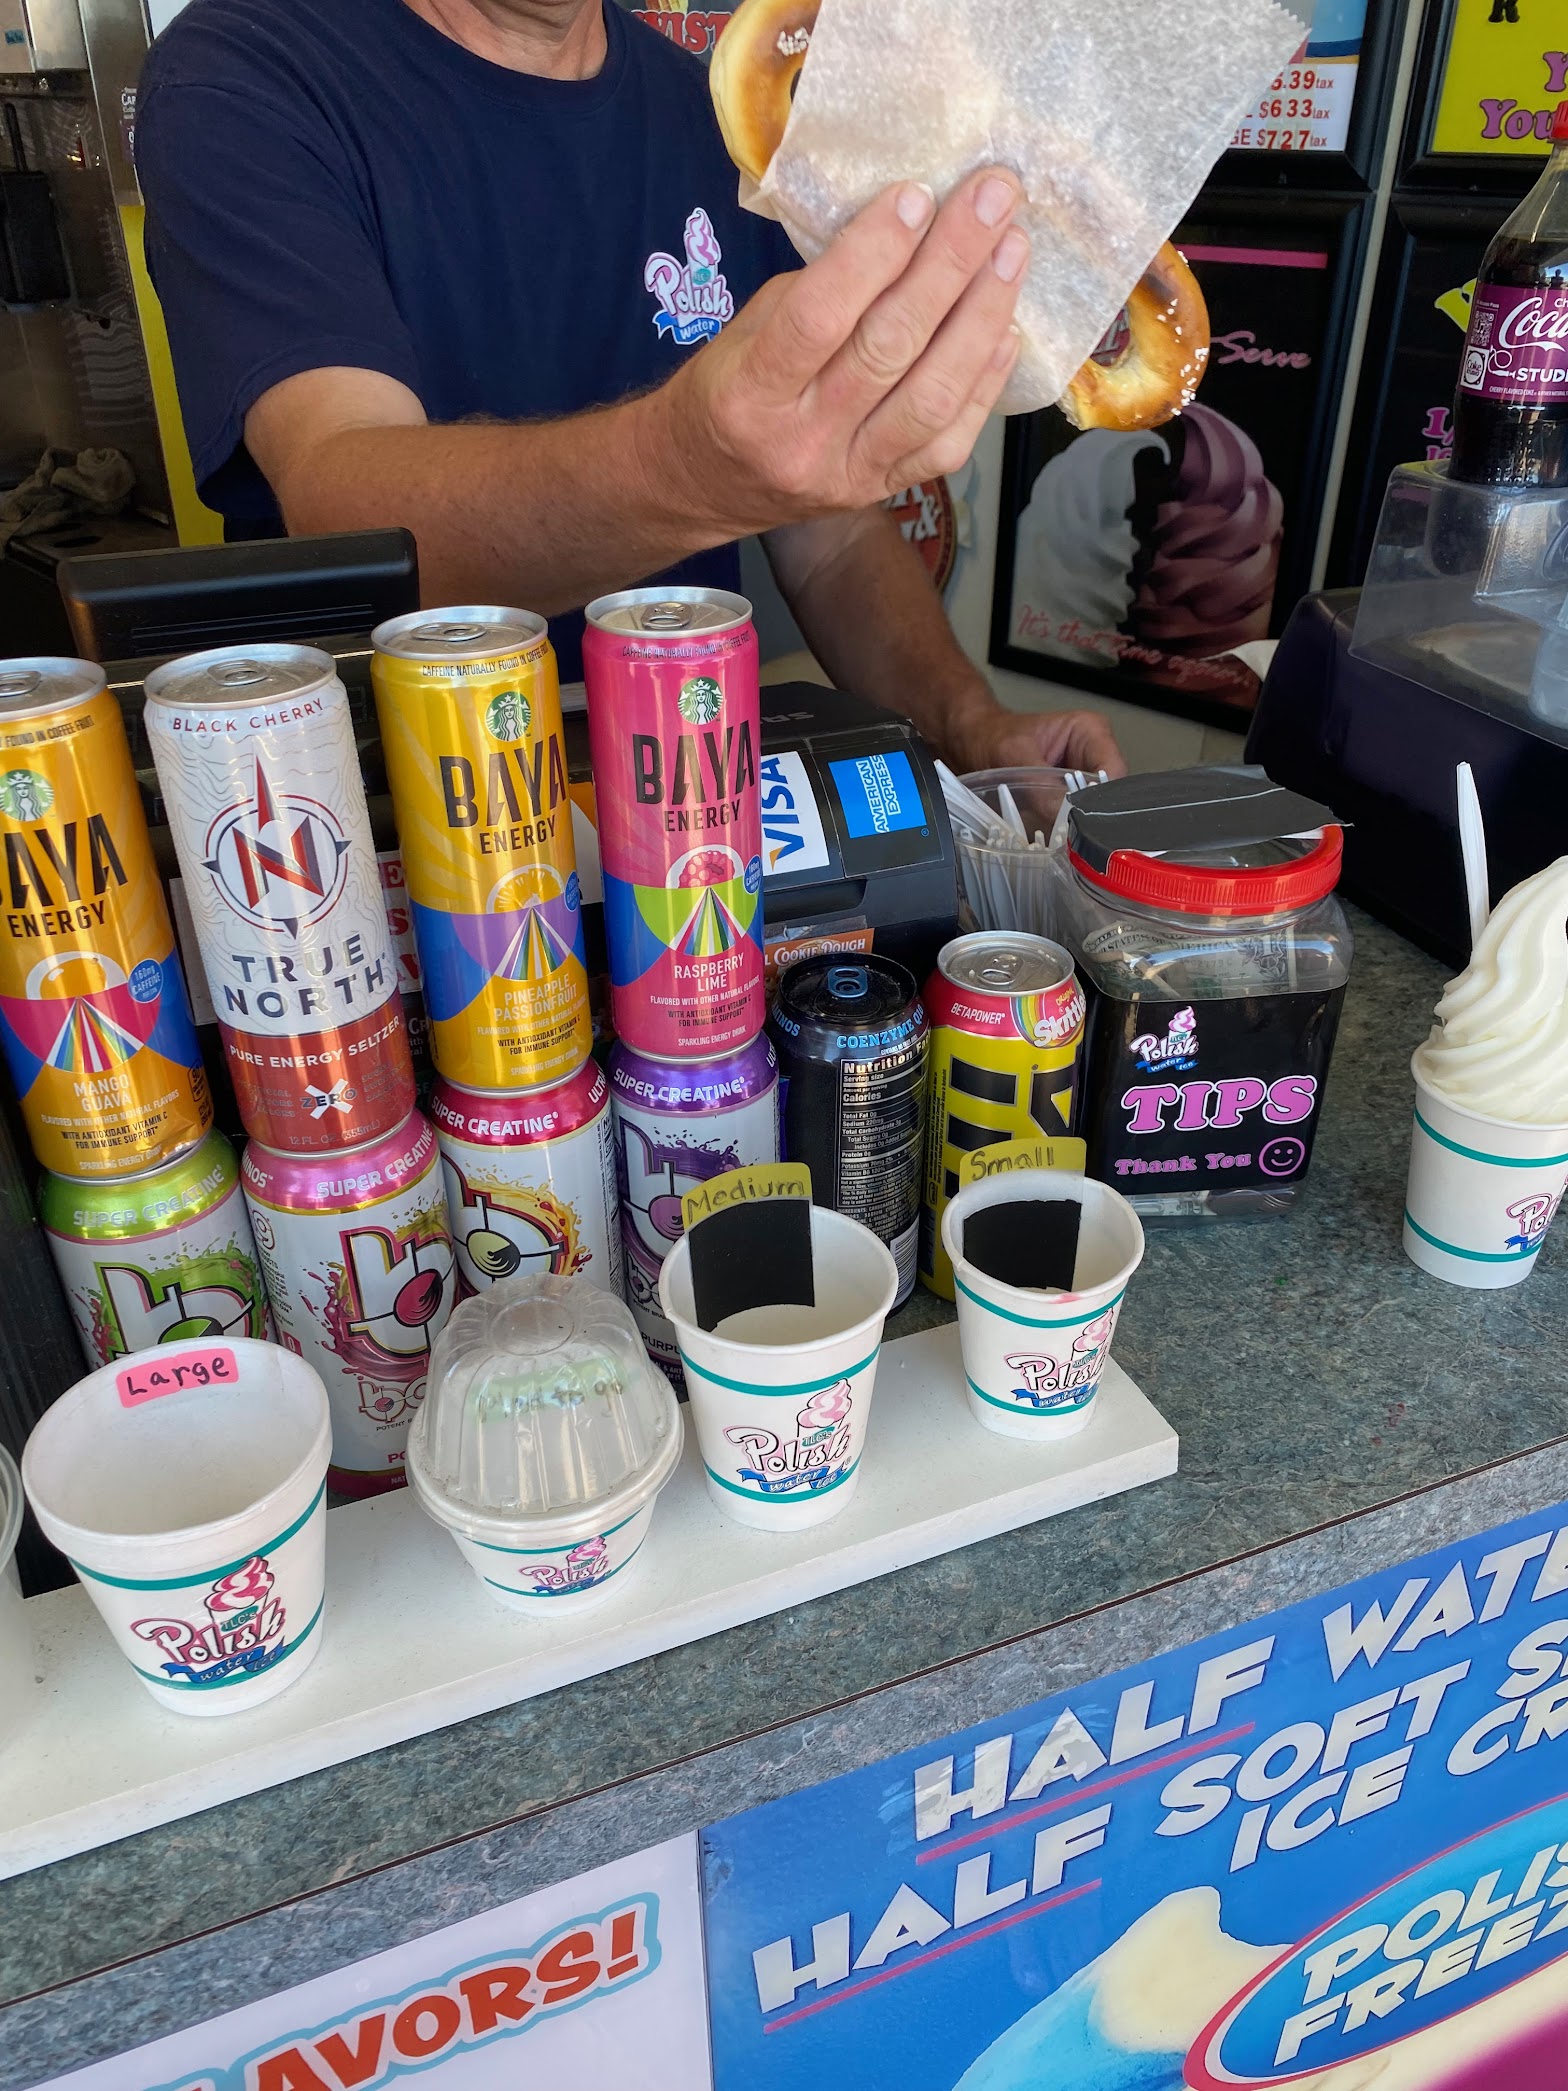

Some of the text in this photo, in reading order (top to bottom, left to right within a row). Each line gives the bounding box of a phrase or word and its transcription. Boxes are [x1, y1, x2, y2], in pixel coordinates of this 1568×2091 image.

[1316, 79, 1333, 88] tax
[645, 252, 734, 321] Polish
[422, 665, 454, 677] CAFFEINE
[456, 662, 496, 676] NATURALLY
[498, 656, 519, 671] FOUND
[622, 646, 652, 658] CAFFEINE
[47, 723, 76, 739] COFFEE
[173, 698, 324, 733] BLACK CHERRY
[632, 719, 755, 806] BAYA
[439, 732, 567, 828] BAYA
[869, 754, 901, 816] EXPRESS
[763, 756, 805, 862] VISA
[856, 760, 890, 833] AMERICAN
[664, 800, 741, 832] ENERGY
[480, 815, 556, 854] ENERGY
[0, 813, 128, 910] AYA
[7, 900, 106, 938] ENERGY
[232, 934, 364, 983] TRUE
[674, 953, 744, 979] RASPBERRY
[774, 946, 818, 967] COOKIE
[821, 938, 866, 953] DOUGH
[224, 957, 385, 1016] NORTH
[504, 973, 570, 1006] PINEAPPLE
[650, 987, 743, 1006] FLAVORED WITH OTHER NATURAL
[697, 974, 727, 992] LIME
[494, 983, 577, 1021] PASSIONFRUIT
[667, 998, 748, 1019] WITH ANTIOXIDANT VITAMIN
[950, 1002, 1002, 1025] BETAPOWER
[477, 1026, 510, 1036] FLAVORED
[692, 1016, 717, 1027] IMMUNE
[837, 1018, 916, 1049] COENZYME
[1034, 994, 1087, 1047] Skittle
[229, 1015, 400, 1068] PURE ENERGY SELTZER
[497, 1038, 515, 1047] WITH
[517, 1028, 557, 1046] ANTIOXIDANT
[510, 1040, 550, 1055] FOR IMMUNE
[677, 1030, 732, 1047] SPARKLING ENERGY
[1129, 1033, 1199, 1062] Polish
[844, 1050, 913, 1073] Nutrition
[73, 1074, 131, 1097] MANGO
[614, 1067, 654, 1099] SUPER
[658, 1079, 742, 1103] CREATINE
[844, 1075, 869, 1083] Serving
[74, 1116, 92, 1127] WITH
[153, 1089, 180, 1110] FLAVORS
[81, 1091, 133, 1112] GUAVA
[301, 1087, 357, 1108] ZERO
[843, 1091, 882, 1103] Calories
[1121, 1075, 1317, 1134] TIPS
[61, 1111, 168, 1140] WITH ANTIOXIDANT VITAMIN C
[431, 1095, 465, 1130] SUPER
[467, 1115, 555, 1136] CREATINE
[858, 1122, 895, 1134] Carbohydrate
[76, 1138, 123, 1149] FOR IMMUNE
[854, 1142, 877, 1150] Includes
[80, 1153, 145, 1170] SPARKLING ENERGY
[316, 1170, 383, 1198] SUPER
[385, 1128, 433, 1181] CREATINE
[841, 1161, 869, 1169] Potassium
[970, 1146, 1055, 1181] Small
[1115, 1152, 1251, 1176] Thank You
[73, 1170, 225, 1227] SUPER CREATINE
[686, 1177, 806, 1224] Medium
[1506, 1193, 1562, 1236] Pol
[641, 1331, 680, 1354] PURPL
[126, 1356, 229, 1396] Large
[1004, 1342, 1109, 1391] Polish
[723, 1423, 852, 1475] Polish
[769, 1470, 823, 1492] water
[519, 1555, 609, 1586] Polish
[130, 1597, 286, 1666] Polish
[220, 1609, 258, 1632] TLC's
[200, 1652, 255, 1683] water
[913, 1634, 1276, 1846] HALF
[751, 1619, 1568, 2016] HALF SOFT S
[1229, 1744, 1415, 1874] ICE
